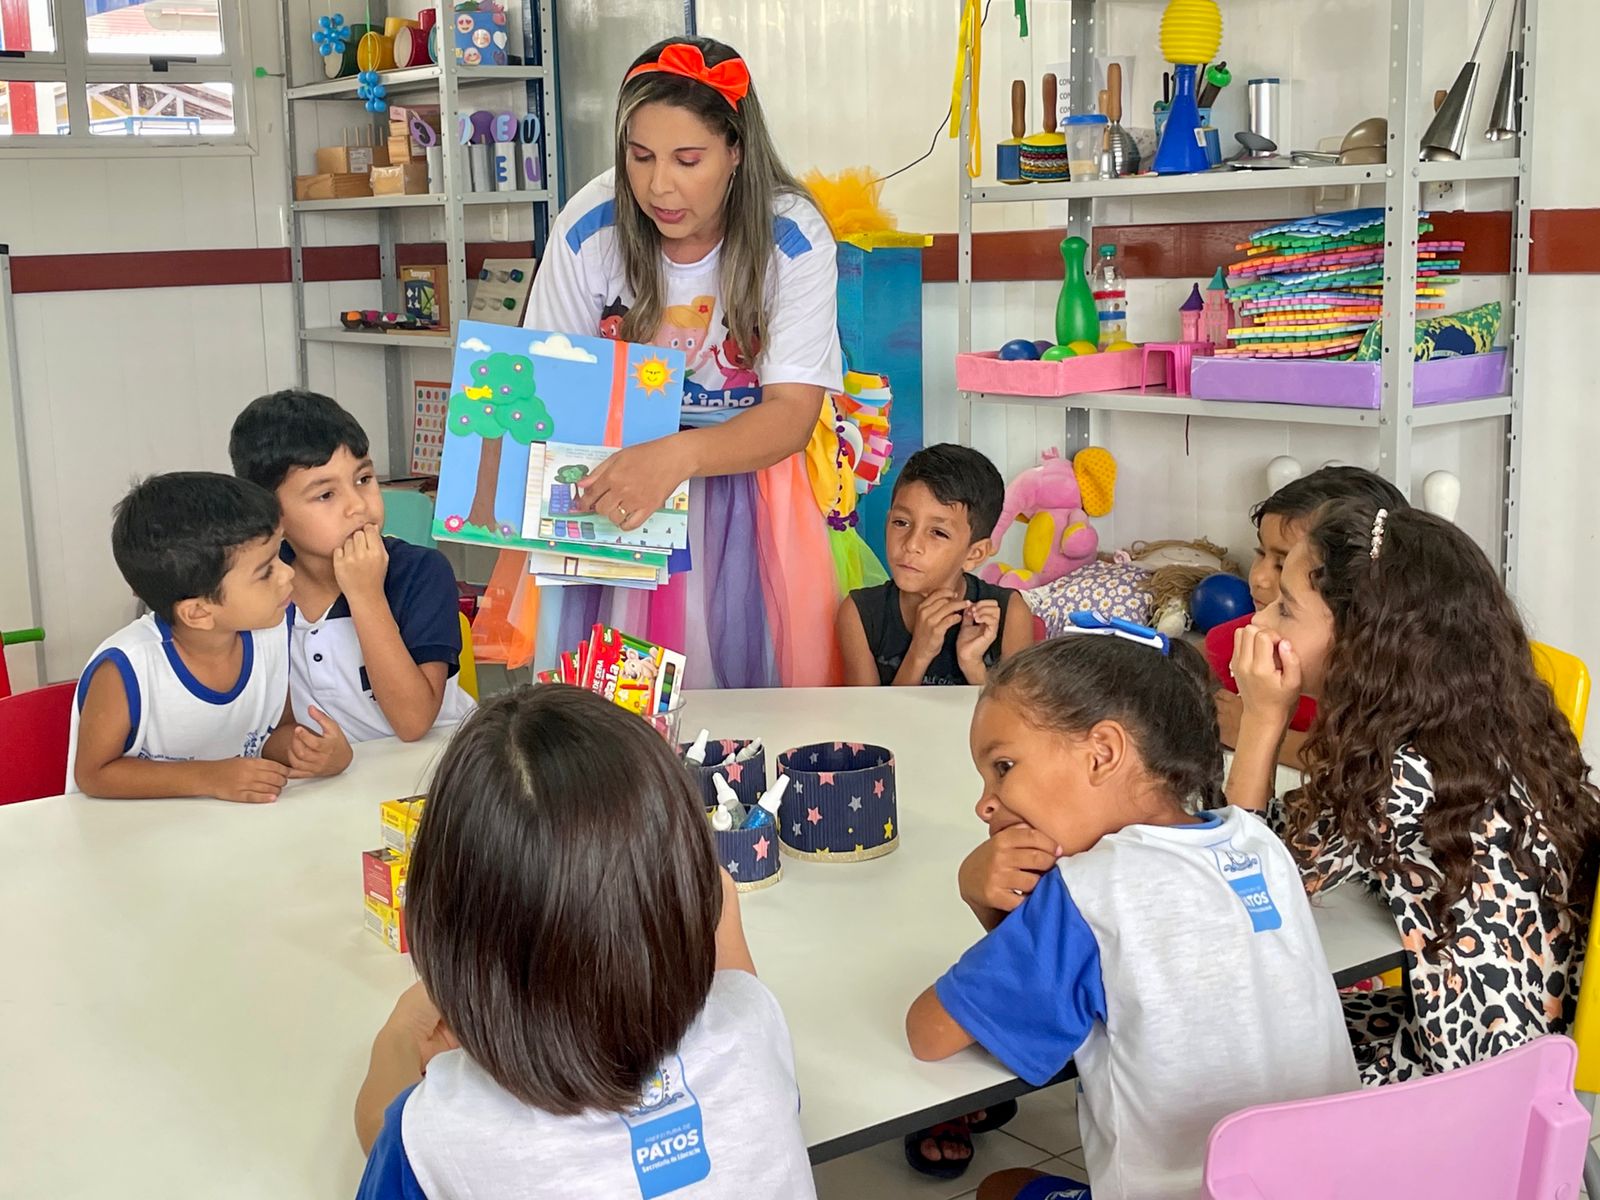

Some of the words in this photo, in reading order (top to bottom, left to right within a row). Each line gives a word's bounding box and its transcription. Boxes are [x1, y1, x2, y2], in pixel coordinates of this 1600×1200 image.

[496, 114, 510, 142] E
[523, 118, 537, 144] U
[495, 155, 508, 183] E
[525, 156, 540, 182] U
[682, 390, 755, 407] tinho
[636, 1129, 699, 1165] PATOS
